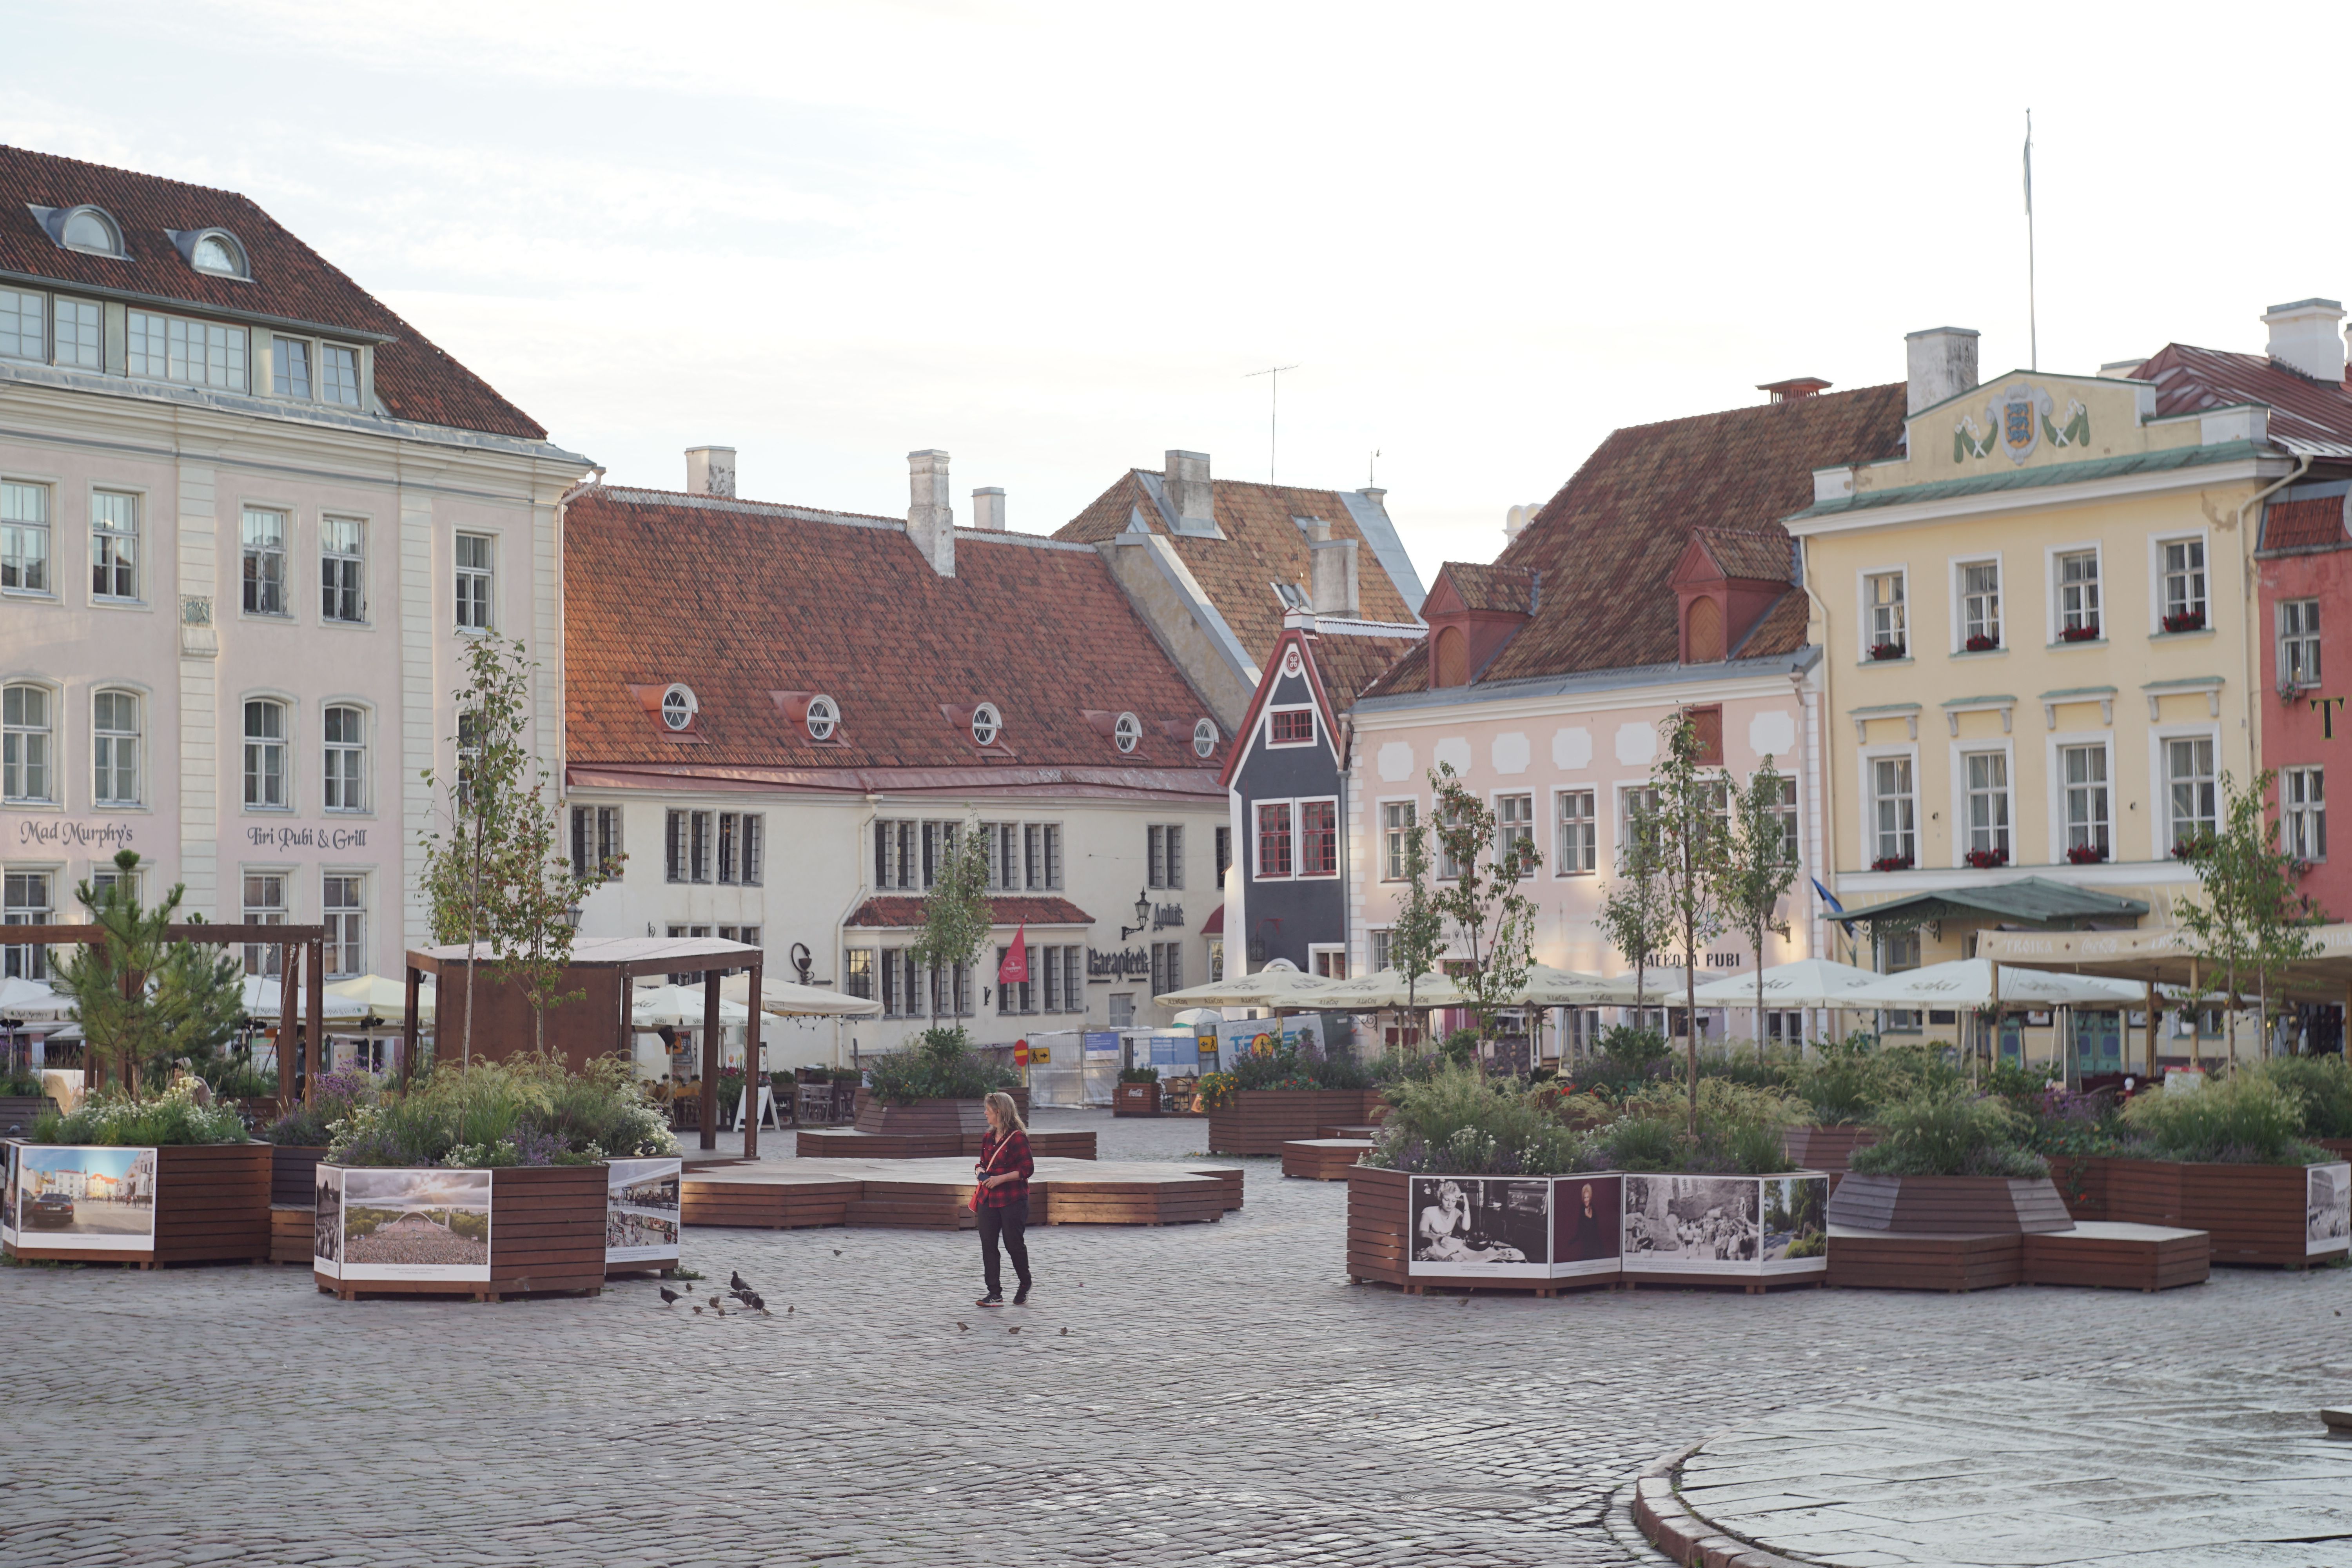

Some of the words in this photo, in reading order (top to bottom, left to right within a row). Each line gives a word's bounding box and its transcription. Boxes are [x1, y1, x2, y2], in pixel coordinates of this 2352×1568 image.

[21, 821, 59, 845] Mad
[62, 822, 132, 849] Murphy's
[278, 828, 313, 852] Pubi
[318, 829, 330, 848] &
[333, 829, 367, 850] Grill
[2004, 939, 2053, 954] TROIKA
[1707, 953, 1739, 967] PUBI
